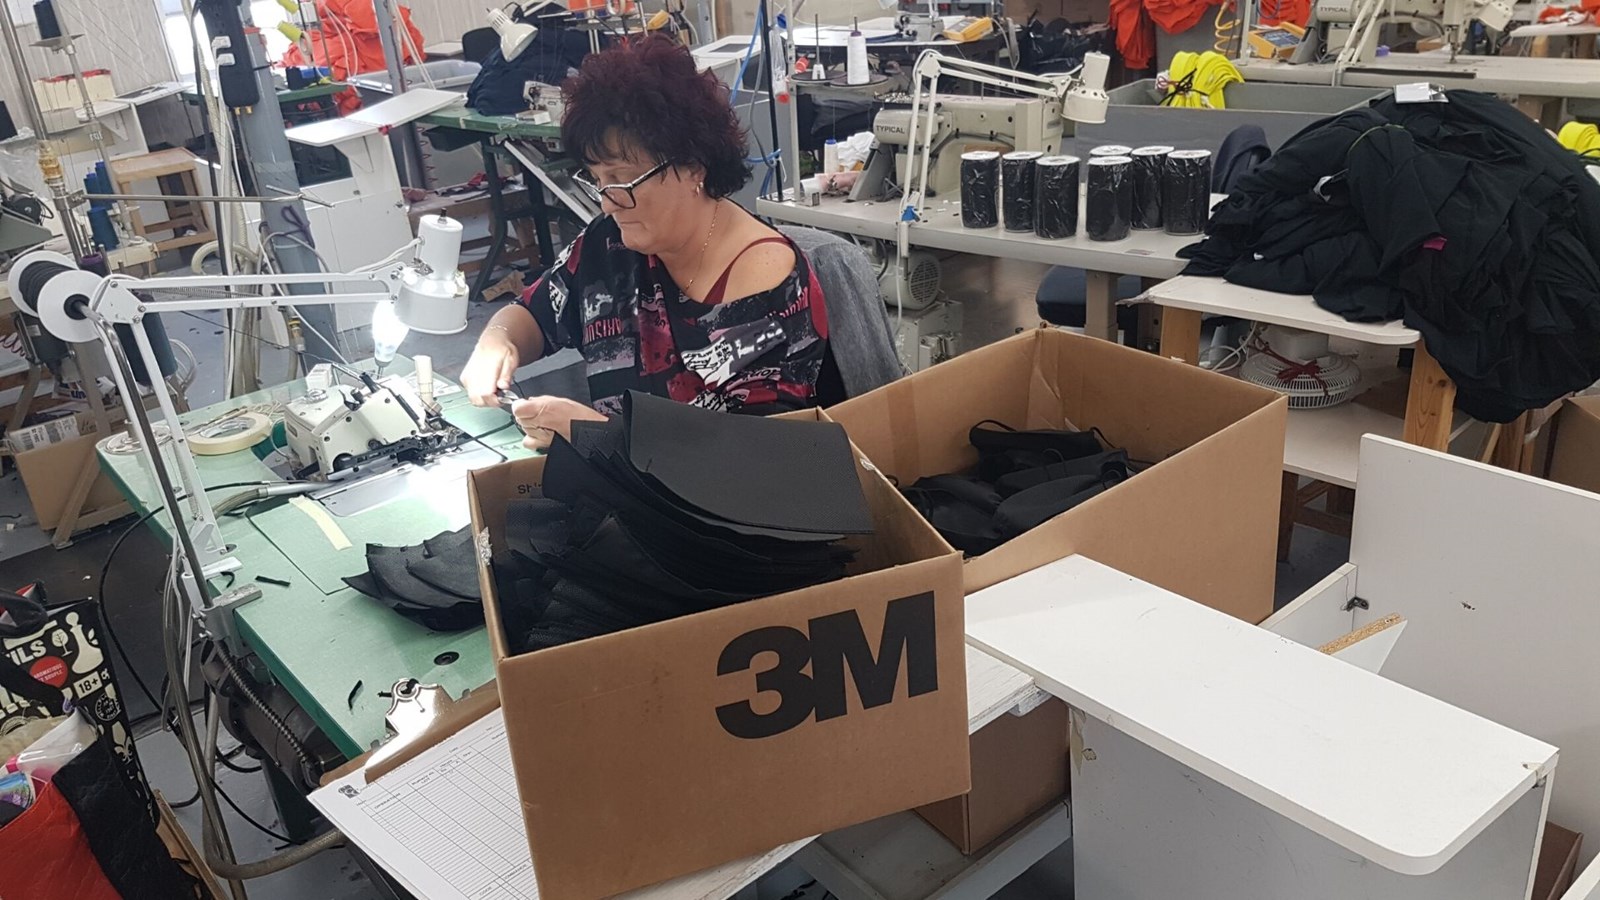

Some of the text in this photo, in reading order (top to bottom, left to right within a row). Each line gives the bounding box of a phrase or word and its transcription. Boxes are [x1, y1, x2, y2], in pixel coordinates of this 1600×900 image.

[876, 125, 905, 134] TYPICAL
[5, 639, 47, 666] ILS
[715, 590, 938, 739] 3M
[78, 677, 99, 694] 18+
